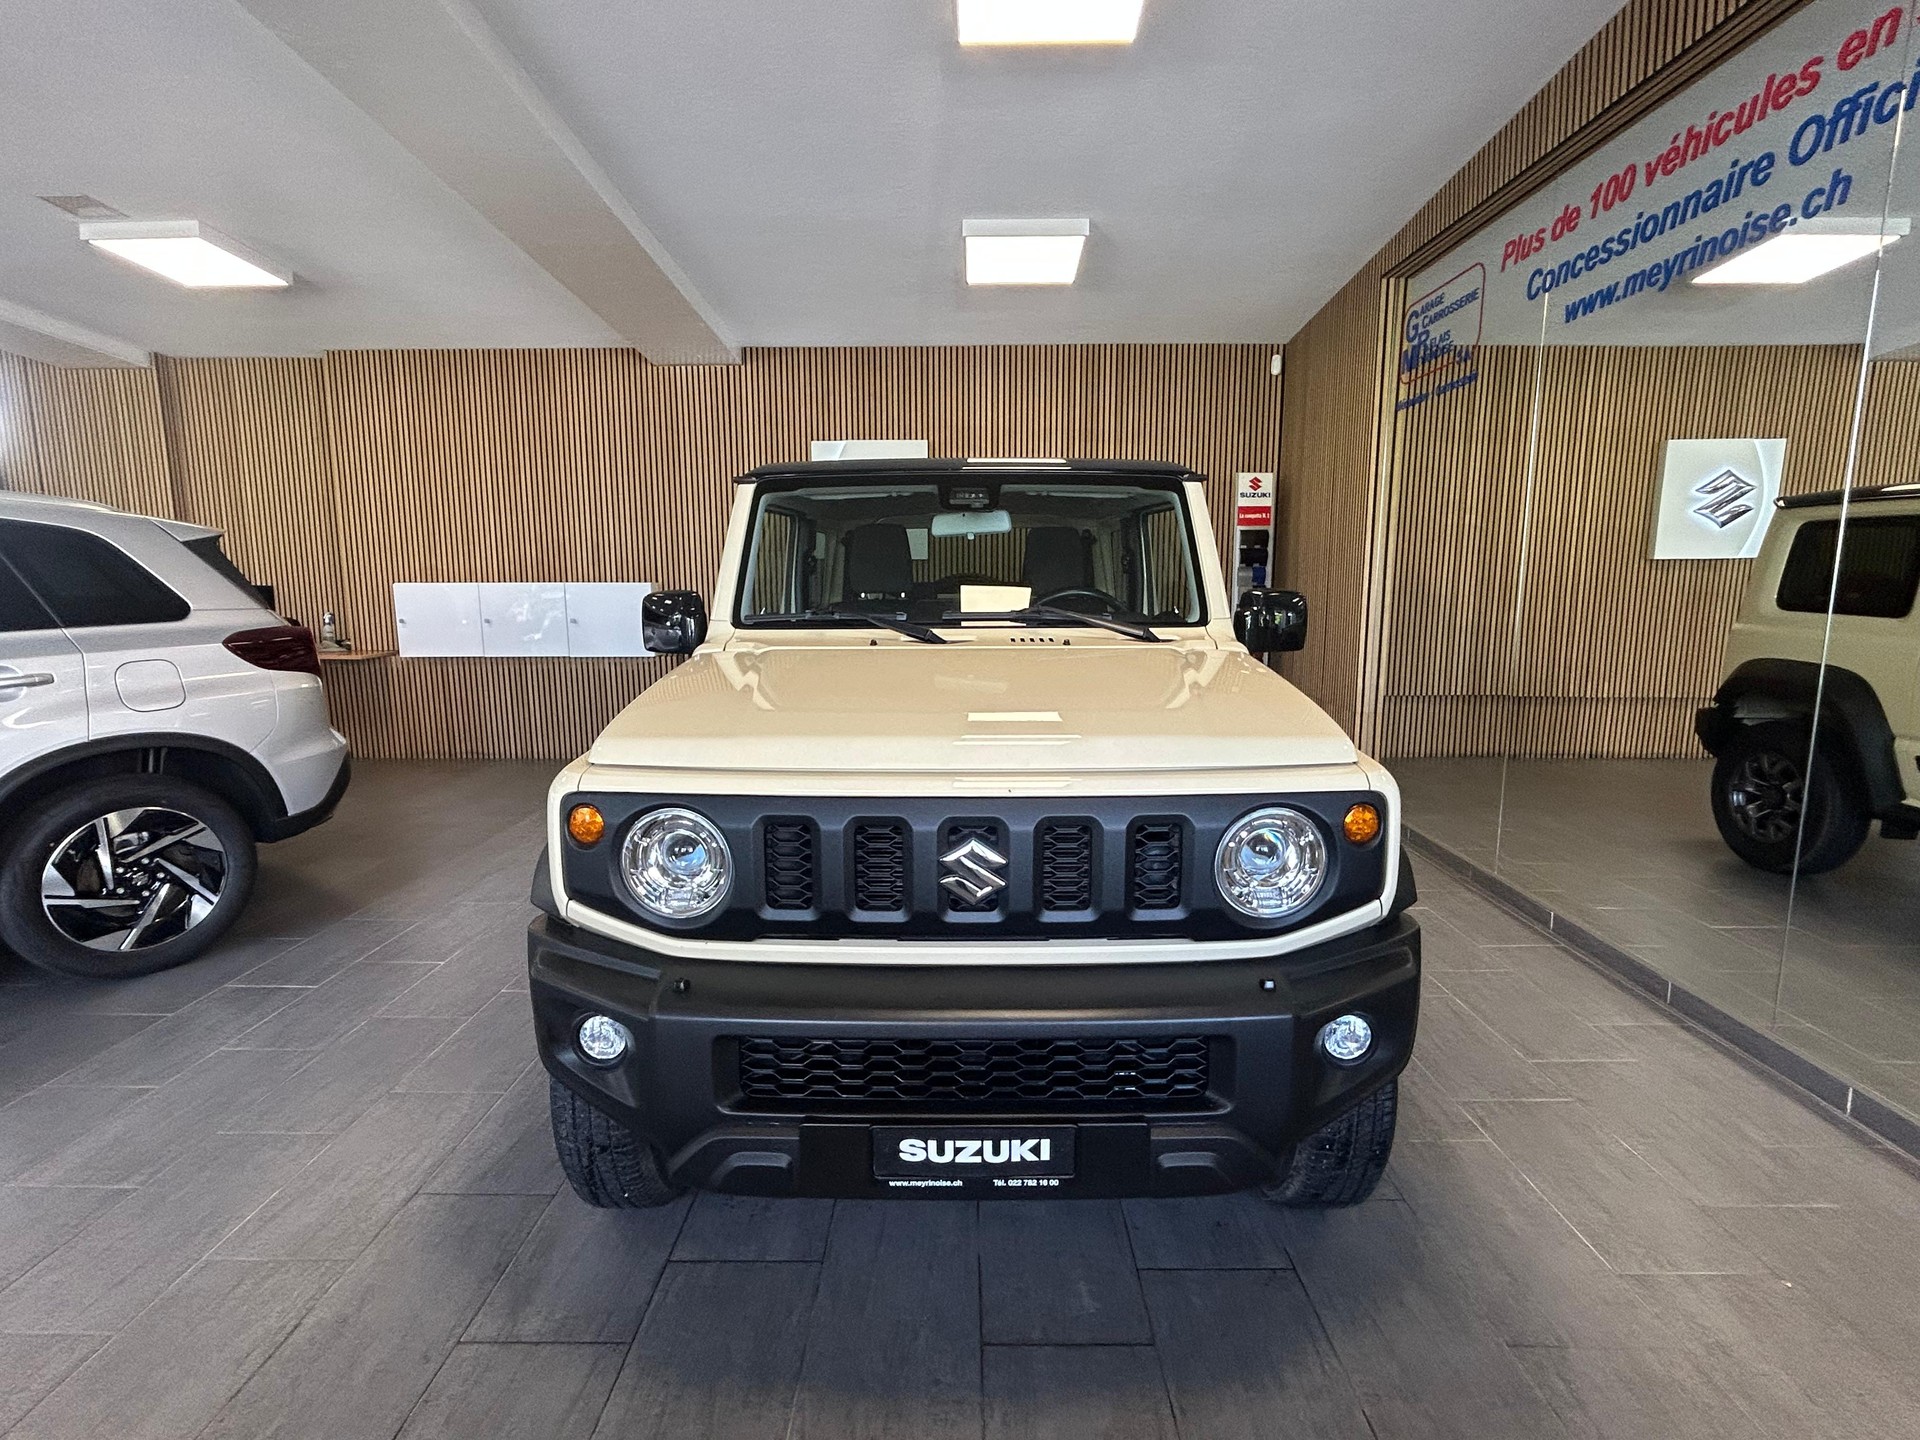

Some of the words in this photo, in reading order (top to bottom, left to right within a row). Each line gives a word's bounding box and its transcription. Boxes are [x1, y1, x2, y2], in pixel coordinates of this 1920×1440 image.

[1501, 232, 1544, 272] Plus
[1551, 202, 1580, 242] de
[1590, 164, 1637, 219] 100
[1645, 55, 1824, 187] véhicules
[1837, 7, 1903, 71] en
[1527, 151, 1775, 301] Concessionnaire
[1564, 169, 1853, 324] www.meyrinoise.ch
[889, 1179, 963, 1188] www.meyrinoise.ch
[1008, 1179, 1022, 1187] 022
[1049, 1179, 1059, 1187] 00
[898, 1138, 1051, 1164] SUZUKI
